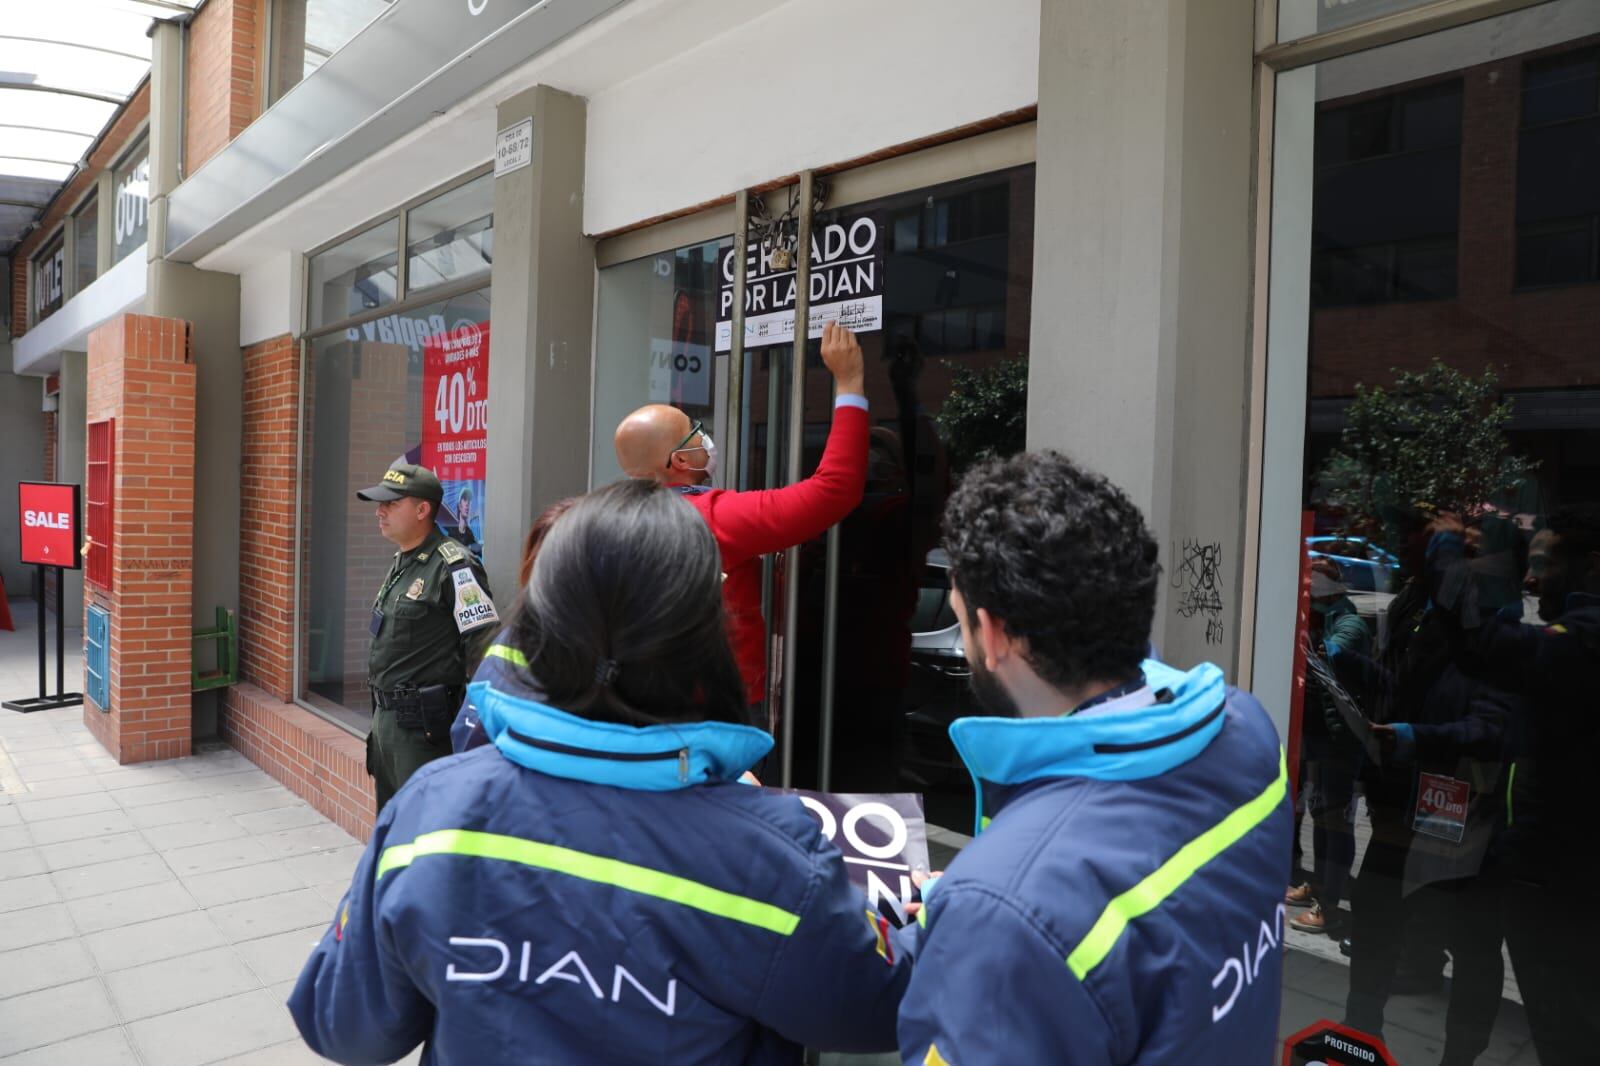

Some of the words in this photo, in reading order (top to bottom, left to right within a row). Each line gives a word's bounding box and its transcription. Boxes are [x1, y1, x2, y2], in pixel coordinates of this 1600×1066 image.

[809, 261, 875, 301] DIAN
[24, 510, 69, 529] SALE
[459, 604, 492, 622] POLICIA
[446, 937, 677, 1016] DIAN
[1324, 1035, 1375, 1062] PROTEGIDO
